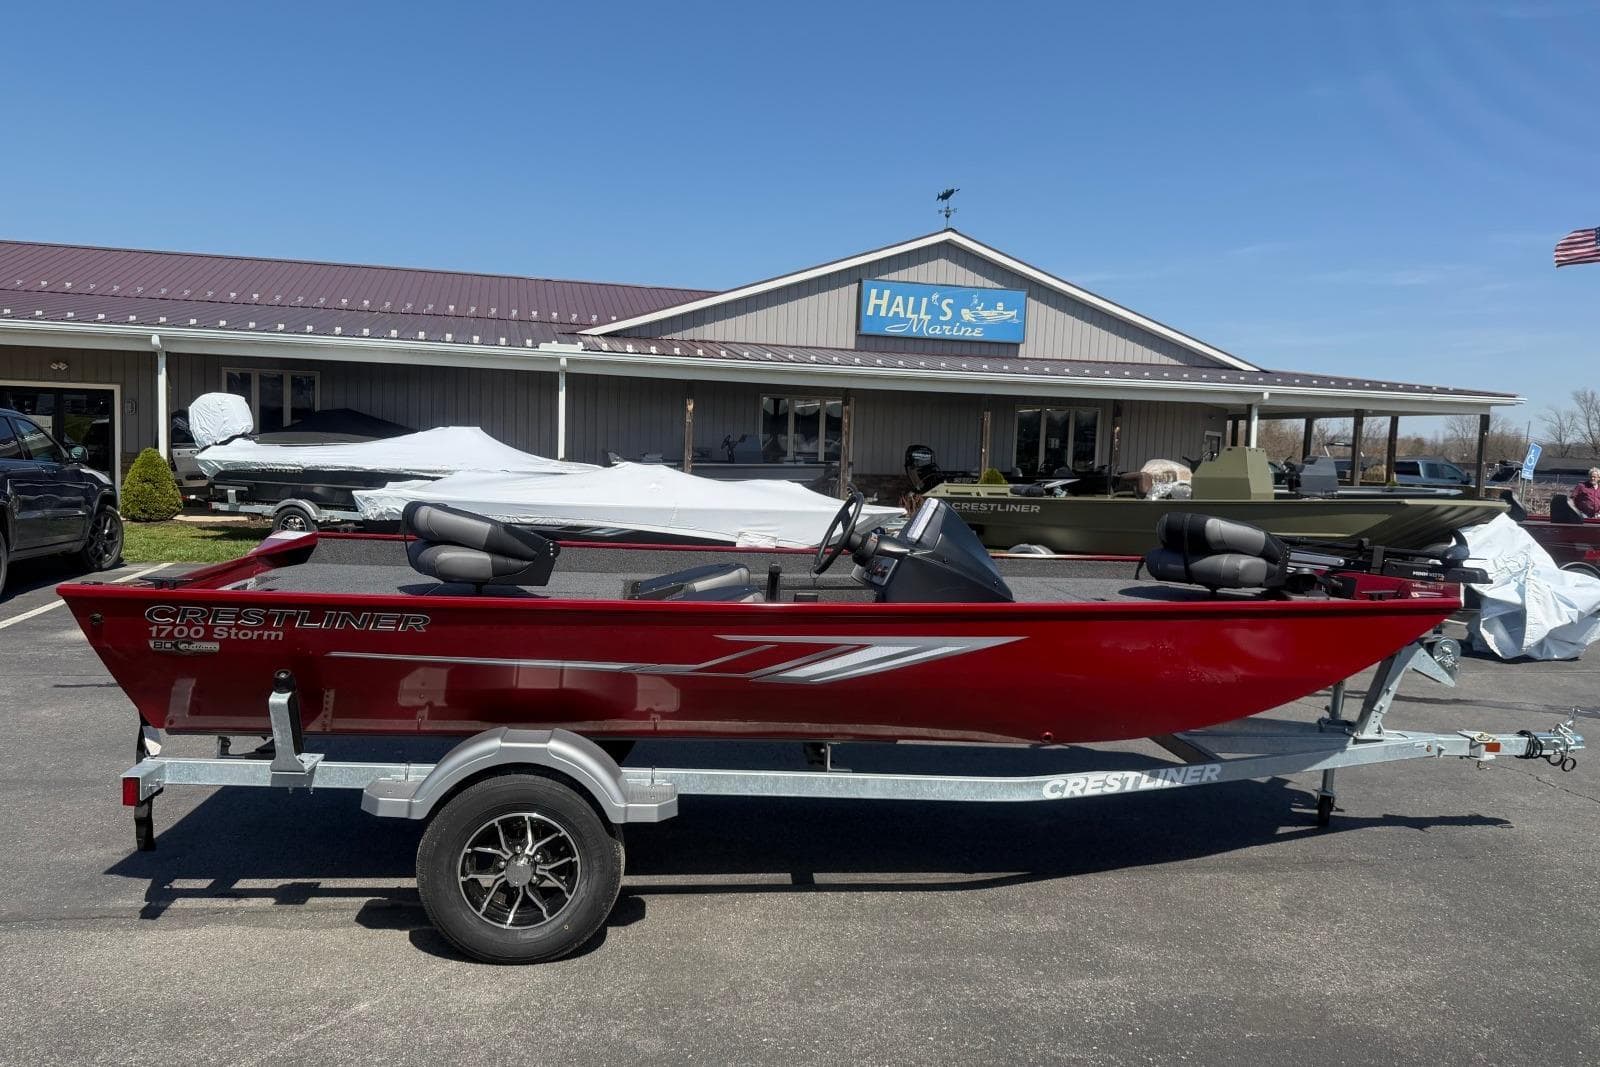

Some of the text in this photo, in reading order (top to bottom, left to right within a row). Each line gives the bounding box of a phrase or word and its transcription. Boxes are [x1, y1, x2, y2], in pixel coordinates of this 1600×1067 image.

[866, 288, 954, 321] HALL'S
[885, 315, 984, 337] Marine
[952, 502, 1040, 513] CRESTLINER
[145, 605, 431, 632] CRESTLINER
[148, 625, 284, 640] 1700 Storm
[1042, 763, 1222, 799] CRESTLINER
